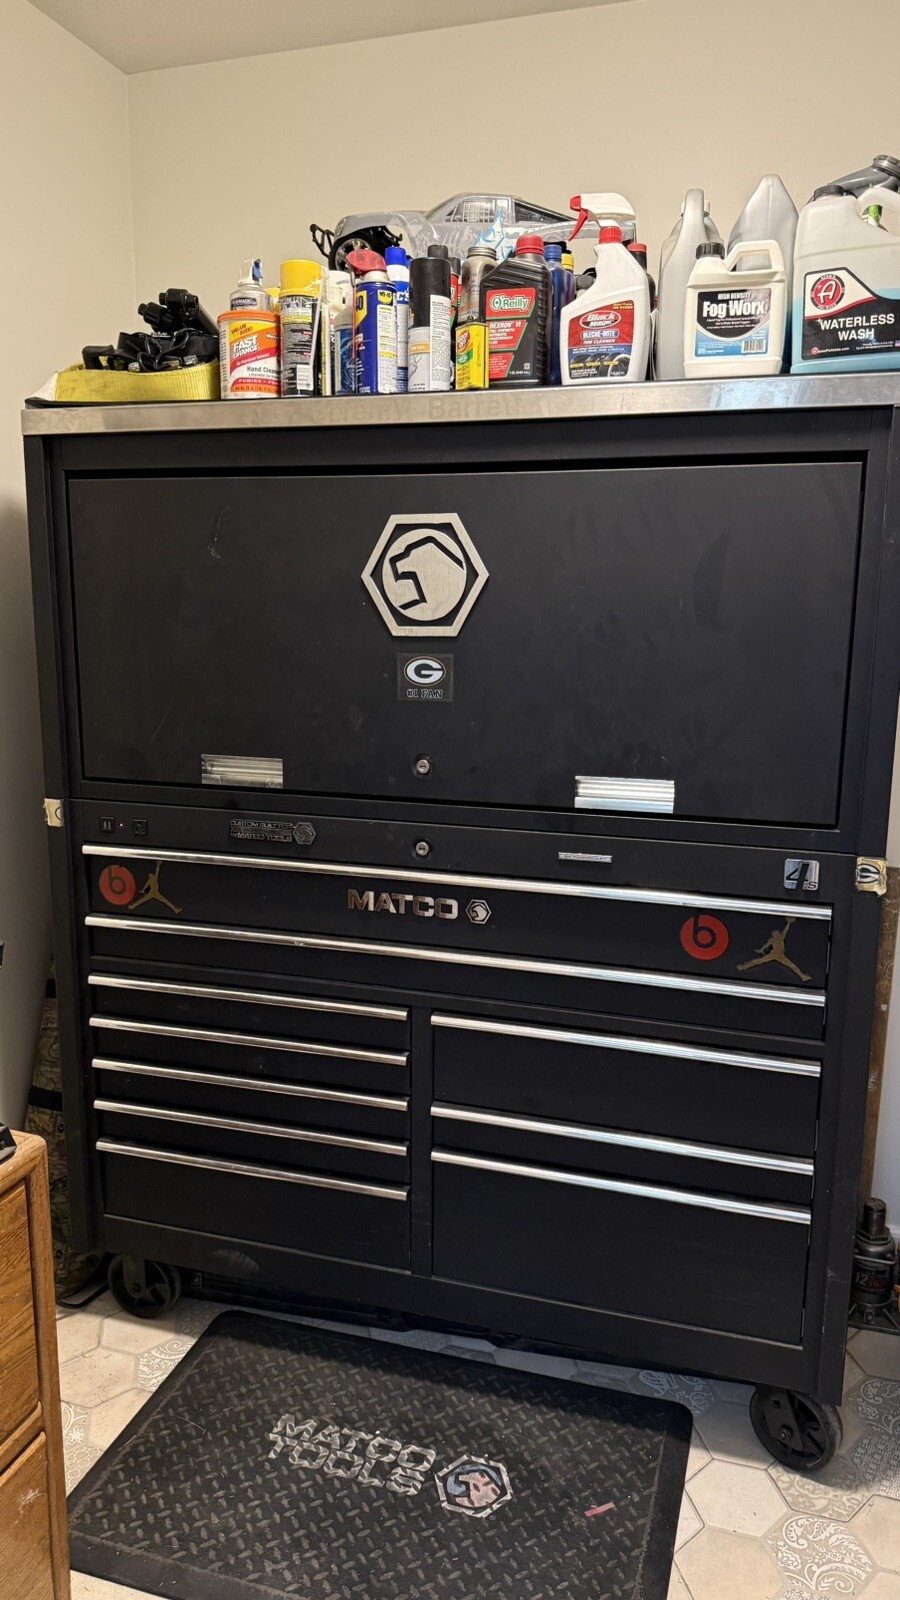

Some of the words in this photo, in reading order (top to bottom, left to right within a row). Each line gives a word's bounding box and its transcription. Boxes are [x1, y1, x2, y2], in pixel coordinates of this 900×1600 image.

[491, 295, 529, 311] O'Reilly
[730, 291, 752, 299] DENSITY
[587, 312, 616, 321] Black
[702, 301, 727, 318] Fog
[728, 300, 765, 316] Worx
[231, 323, 246, 334] VALUE
[820, 313, 895, 331] WATERLESS
[838, 328, 875, 341] WASH
[233, 335, 258, 351] FAST
[406, 659, 444, 684] G
[420, 688, 444, 699] FAN
[348, 889, 459, 920] MATCO
[271, 1413, 437, 1472] MATCO
[268, 1432, 425, 1496] TOOLS
